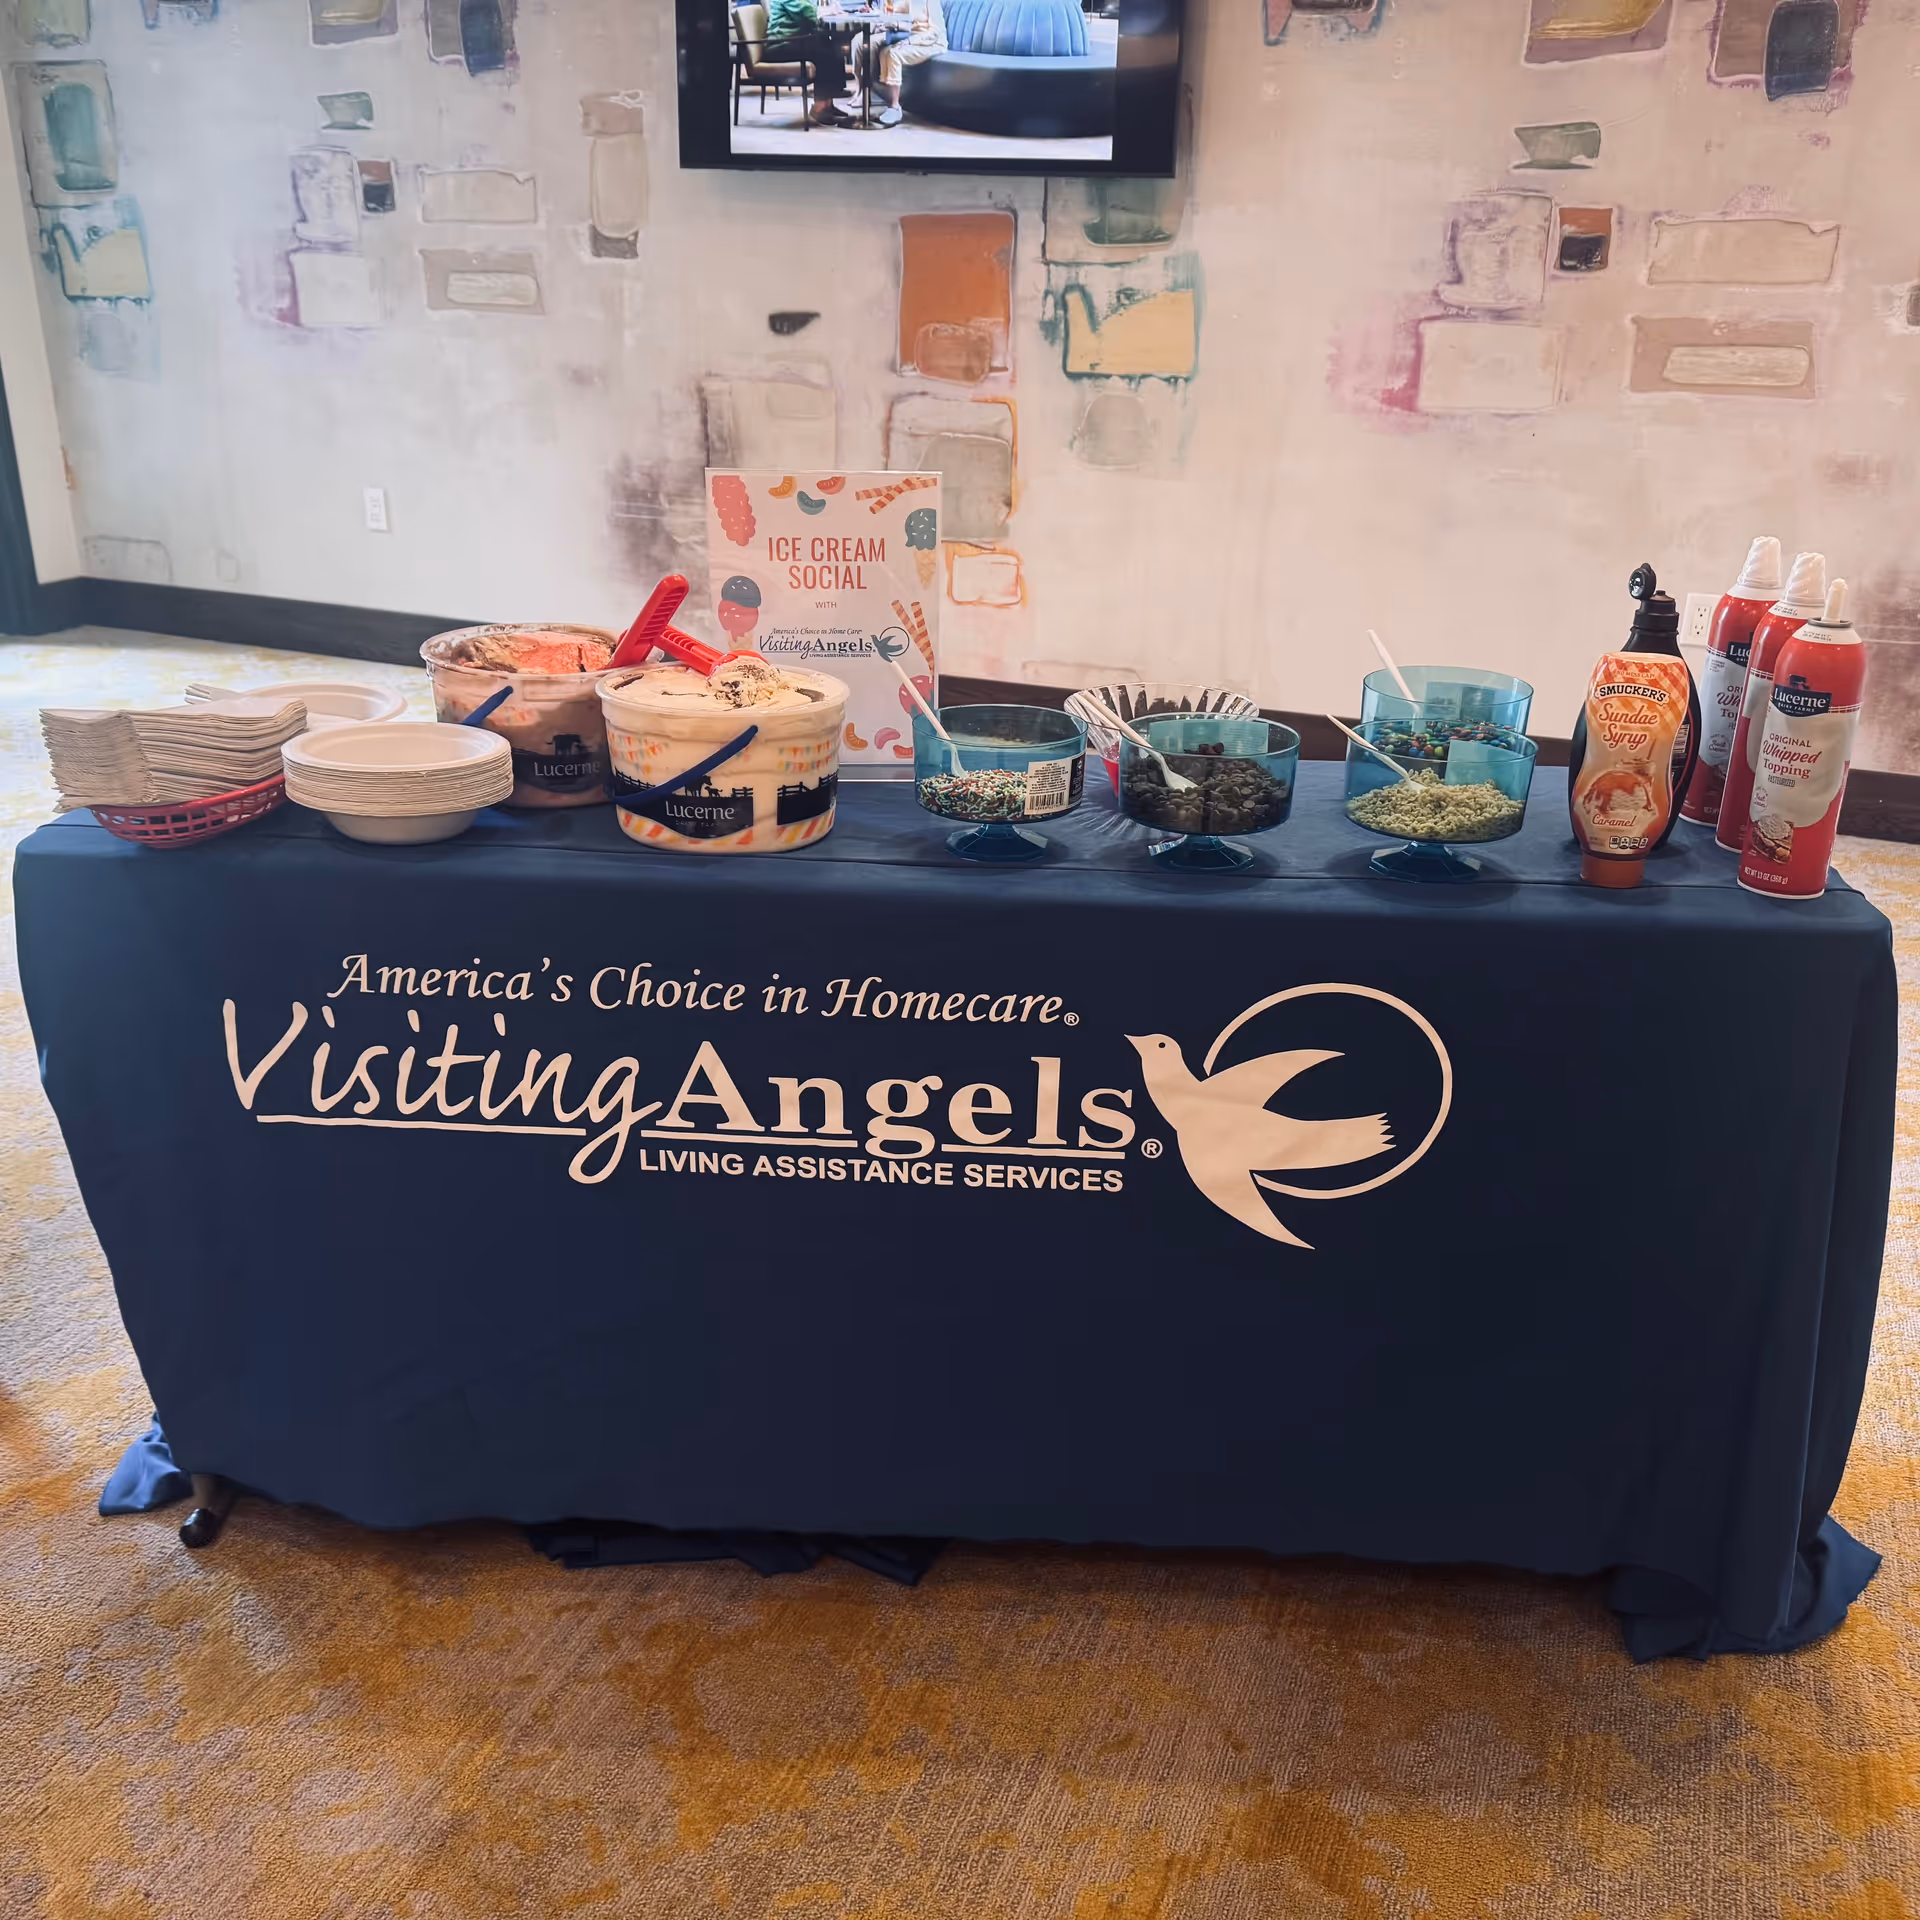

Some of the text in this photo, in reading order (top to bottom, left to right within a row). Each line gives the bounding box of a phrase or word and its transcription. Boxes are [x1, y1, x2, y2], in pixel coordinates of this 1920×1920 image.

[769, 537, 885, 562] ICE CREAM
[788, 565, 867, 590] SOCIAL
[815, 601, 837, 609] WITH
[800, 627, 820, 636] Choice
[759, 635, 873, 660] Visiting Angels
[1599, 685, 1666, 702] SMUCKER'S
[1774, 687, 1826, 708] Lucerne
[1599, 702, 1658, 725] Sundae
[1603, 723, 1648, 750] Syrup
[1769, 733, 1812, 748] ORIGINAL
[1763, 740, 1822, 764] Whipped
[534, 761, 601, 777] Lucerne
[1764, 758, 1811, 779] Topping
[665, 801, 735, 820] Lucerne
[1592, 813, 1637, 827] Caramel
[327, 954, 574, 1002] America's
[590, 963, 746, 1011] Choice
[762, 973, 809, 1015] in
[223, 998, 662, 1185] Visiting
[640, 1149, 1124, 1192] LIVING ASSISTANCE SERVICES
